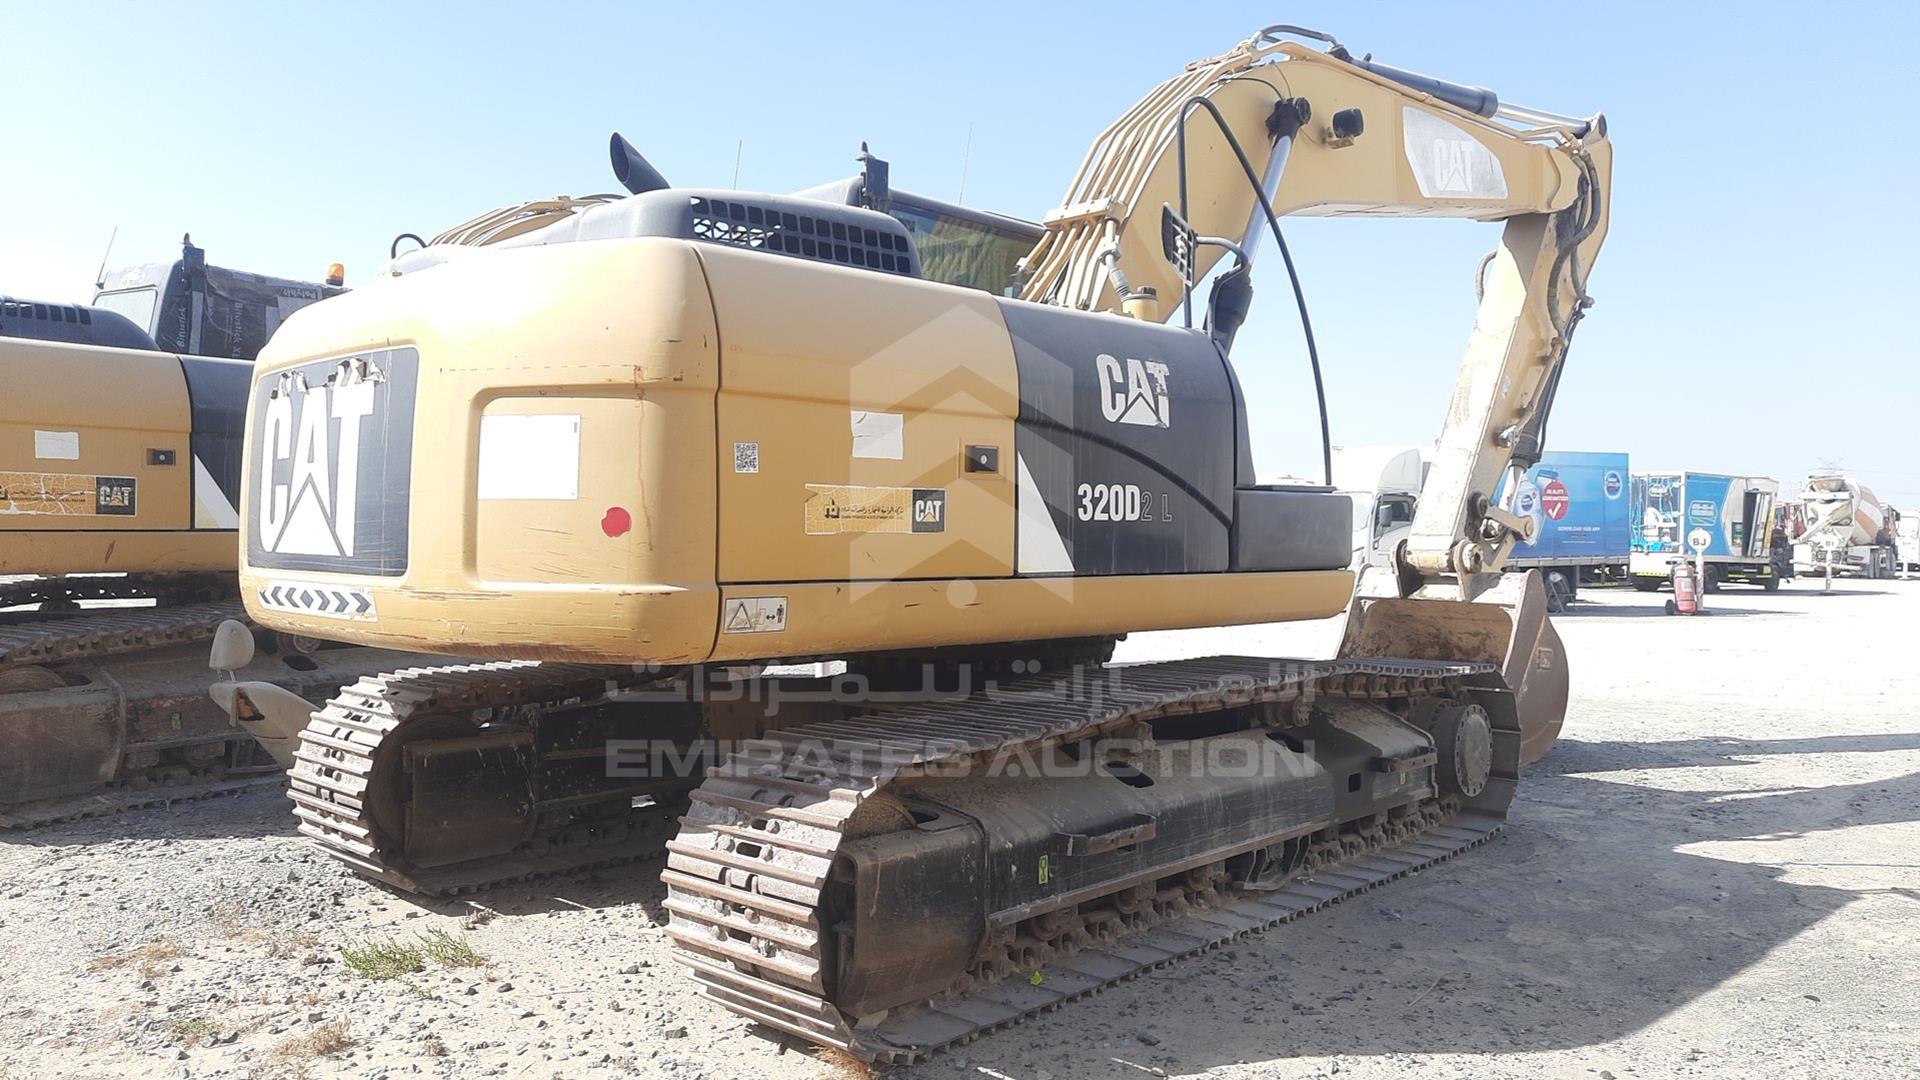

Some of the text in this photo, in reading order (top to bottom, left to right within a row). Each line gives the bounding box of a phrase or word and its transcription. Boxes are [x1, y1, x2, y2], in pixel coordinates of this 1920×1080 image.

[1434, 138, 1473, 192] CAT
[1096, 353, 1170, 429] CAT
[259, 378, 376, 557] CAT
[99, 485, 132, 506] CAT
[915, 499, 943, 522] CAT
[1161, 493, 1173, 522] L
